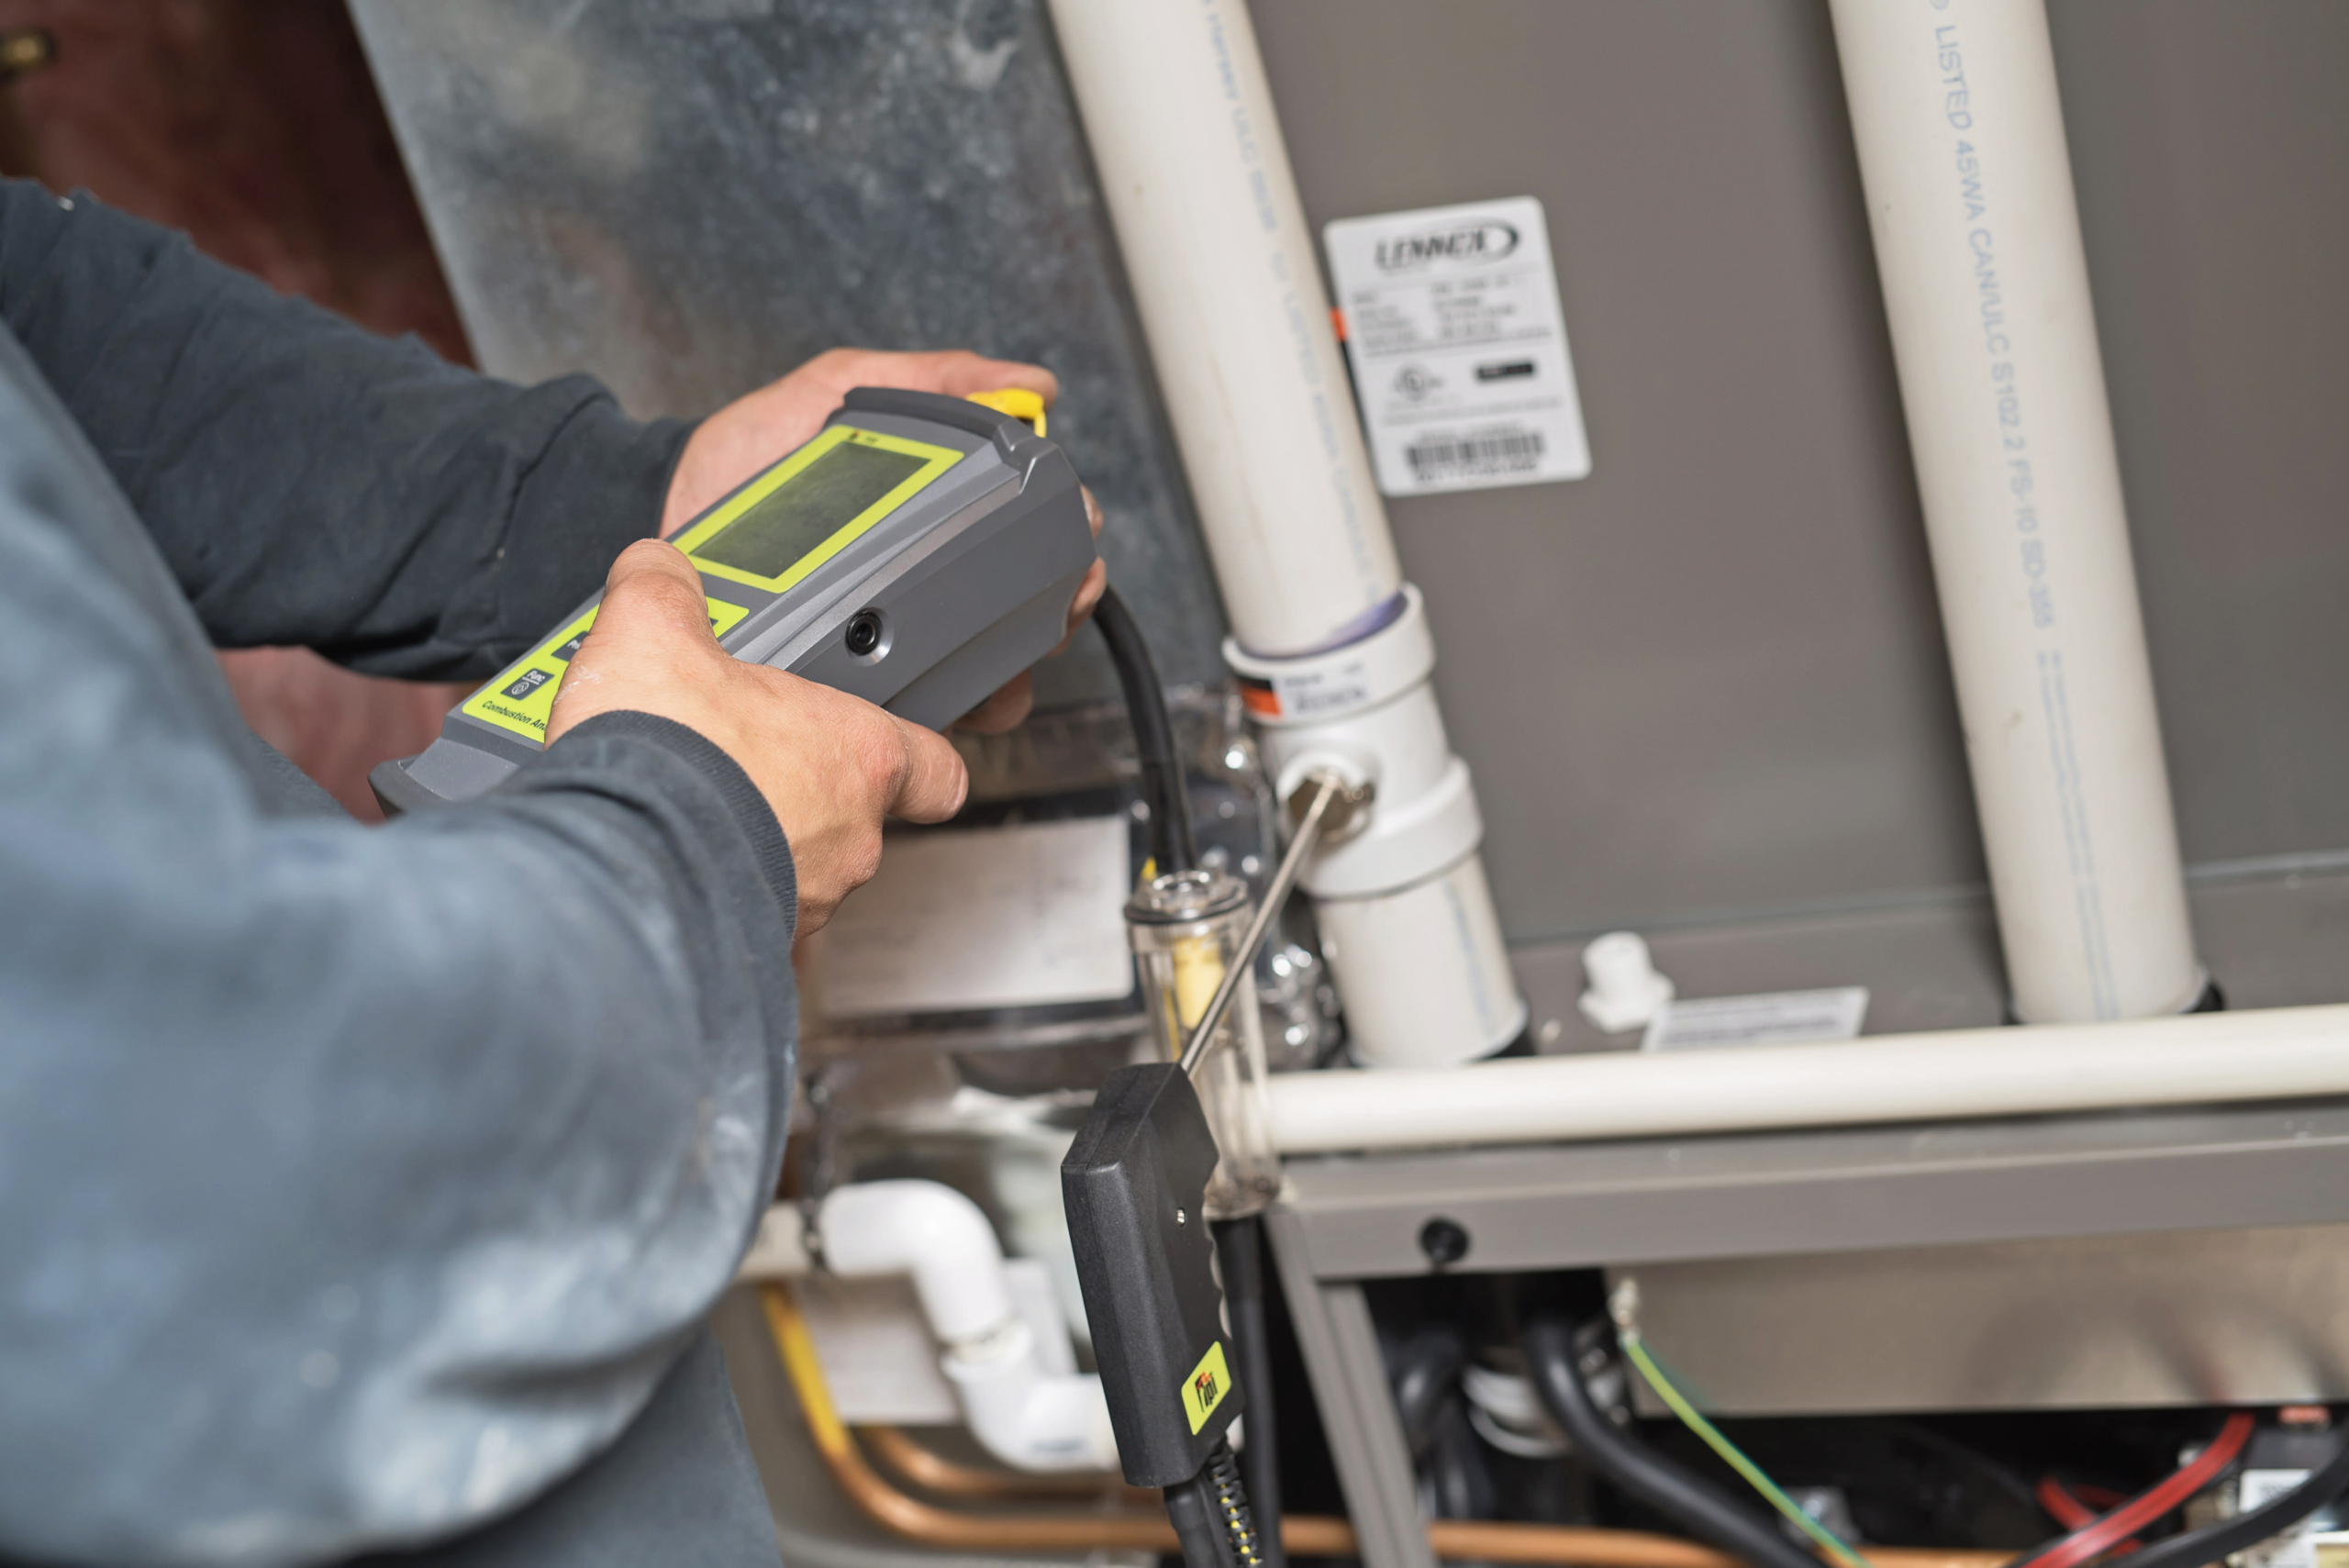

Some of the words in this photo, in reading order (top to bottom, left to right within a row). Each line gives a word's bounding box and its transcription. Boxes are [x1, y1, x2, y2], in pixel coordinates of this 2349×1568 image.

[1934, 25, 1973, 131] LISTED
[1954, 139, 1987, 221] 45WA
[1968, 228, 2010, 356] CAN/ULC
[482, 700, 532, 724] Combustion
